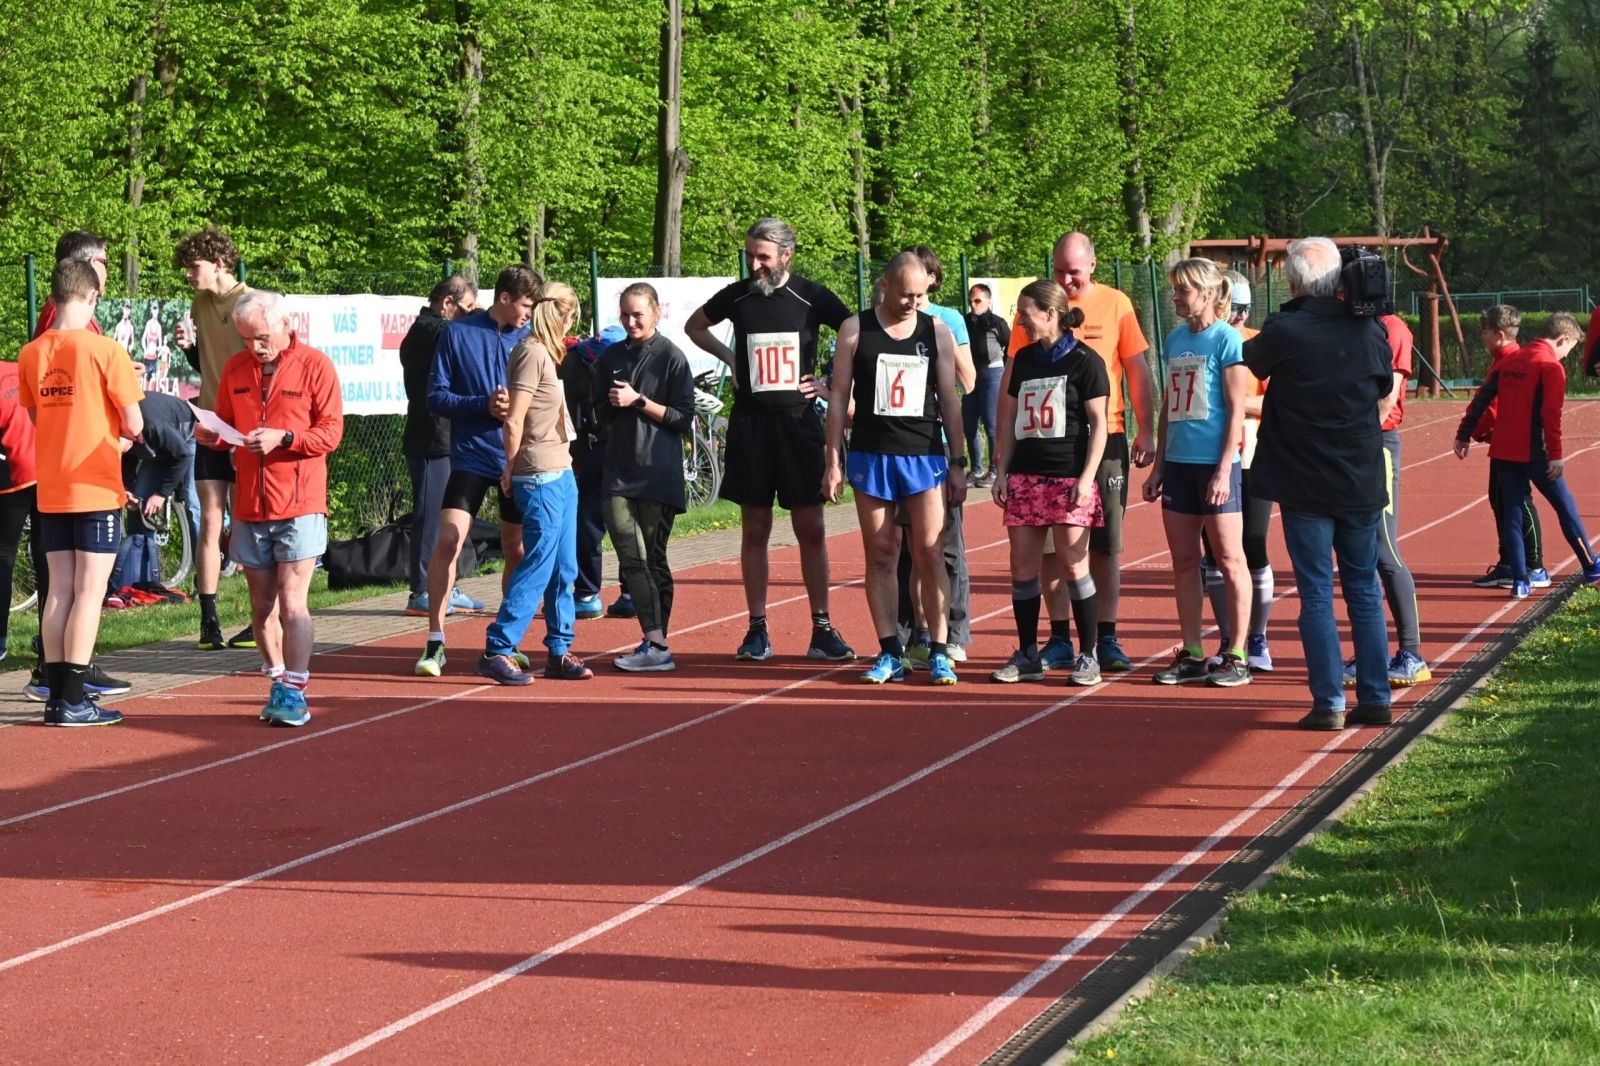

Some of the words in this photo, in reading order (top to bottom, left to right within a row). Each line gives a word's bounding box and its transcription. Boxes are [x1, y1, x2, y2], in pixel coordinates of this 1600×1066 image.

[289, 312, 309, 334] ON
[333, 306, 358, 334] VÁŠ
[316, 345, 375, 366] ARTNER
[755, 346, 796, 385] 105
[340, 380, 382, 402] ABAVU
[890, 369, 905, 408] 6
[1171, 371, 1196, 412] 57
[1022, 389, 1054, 431] 56
